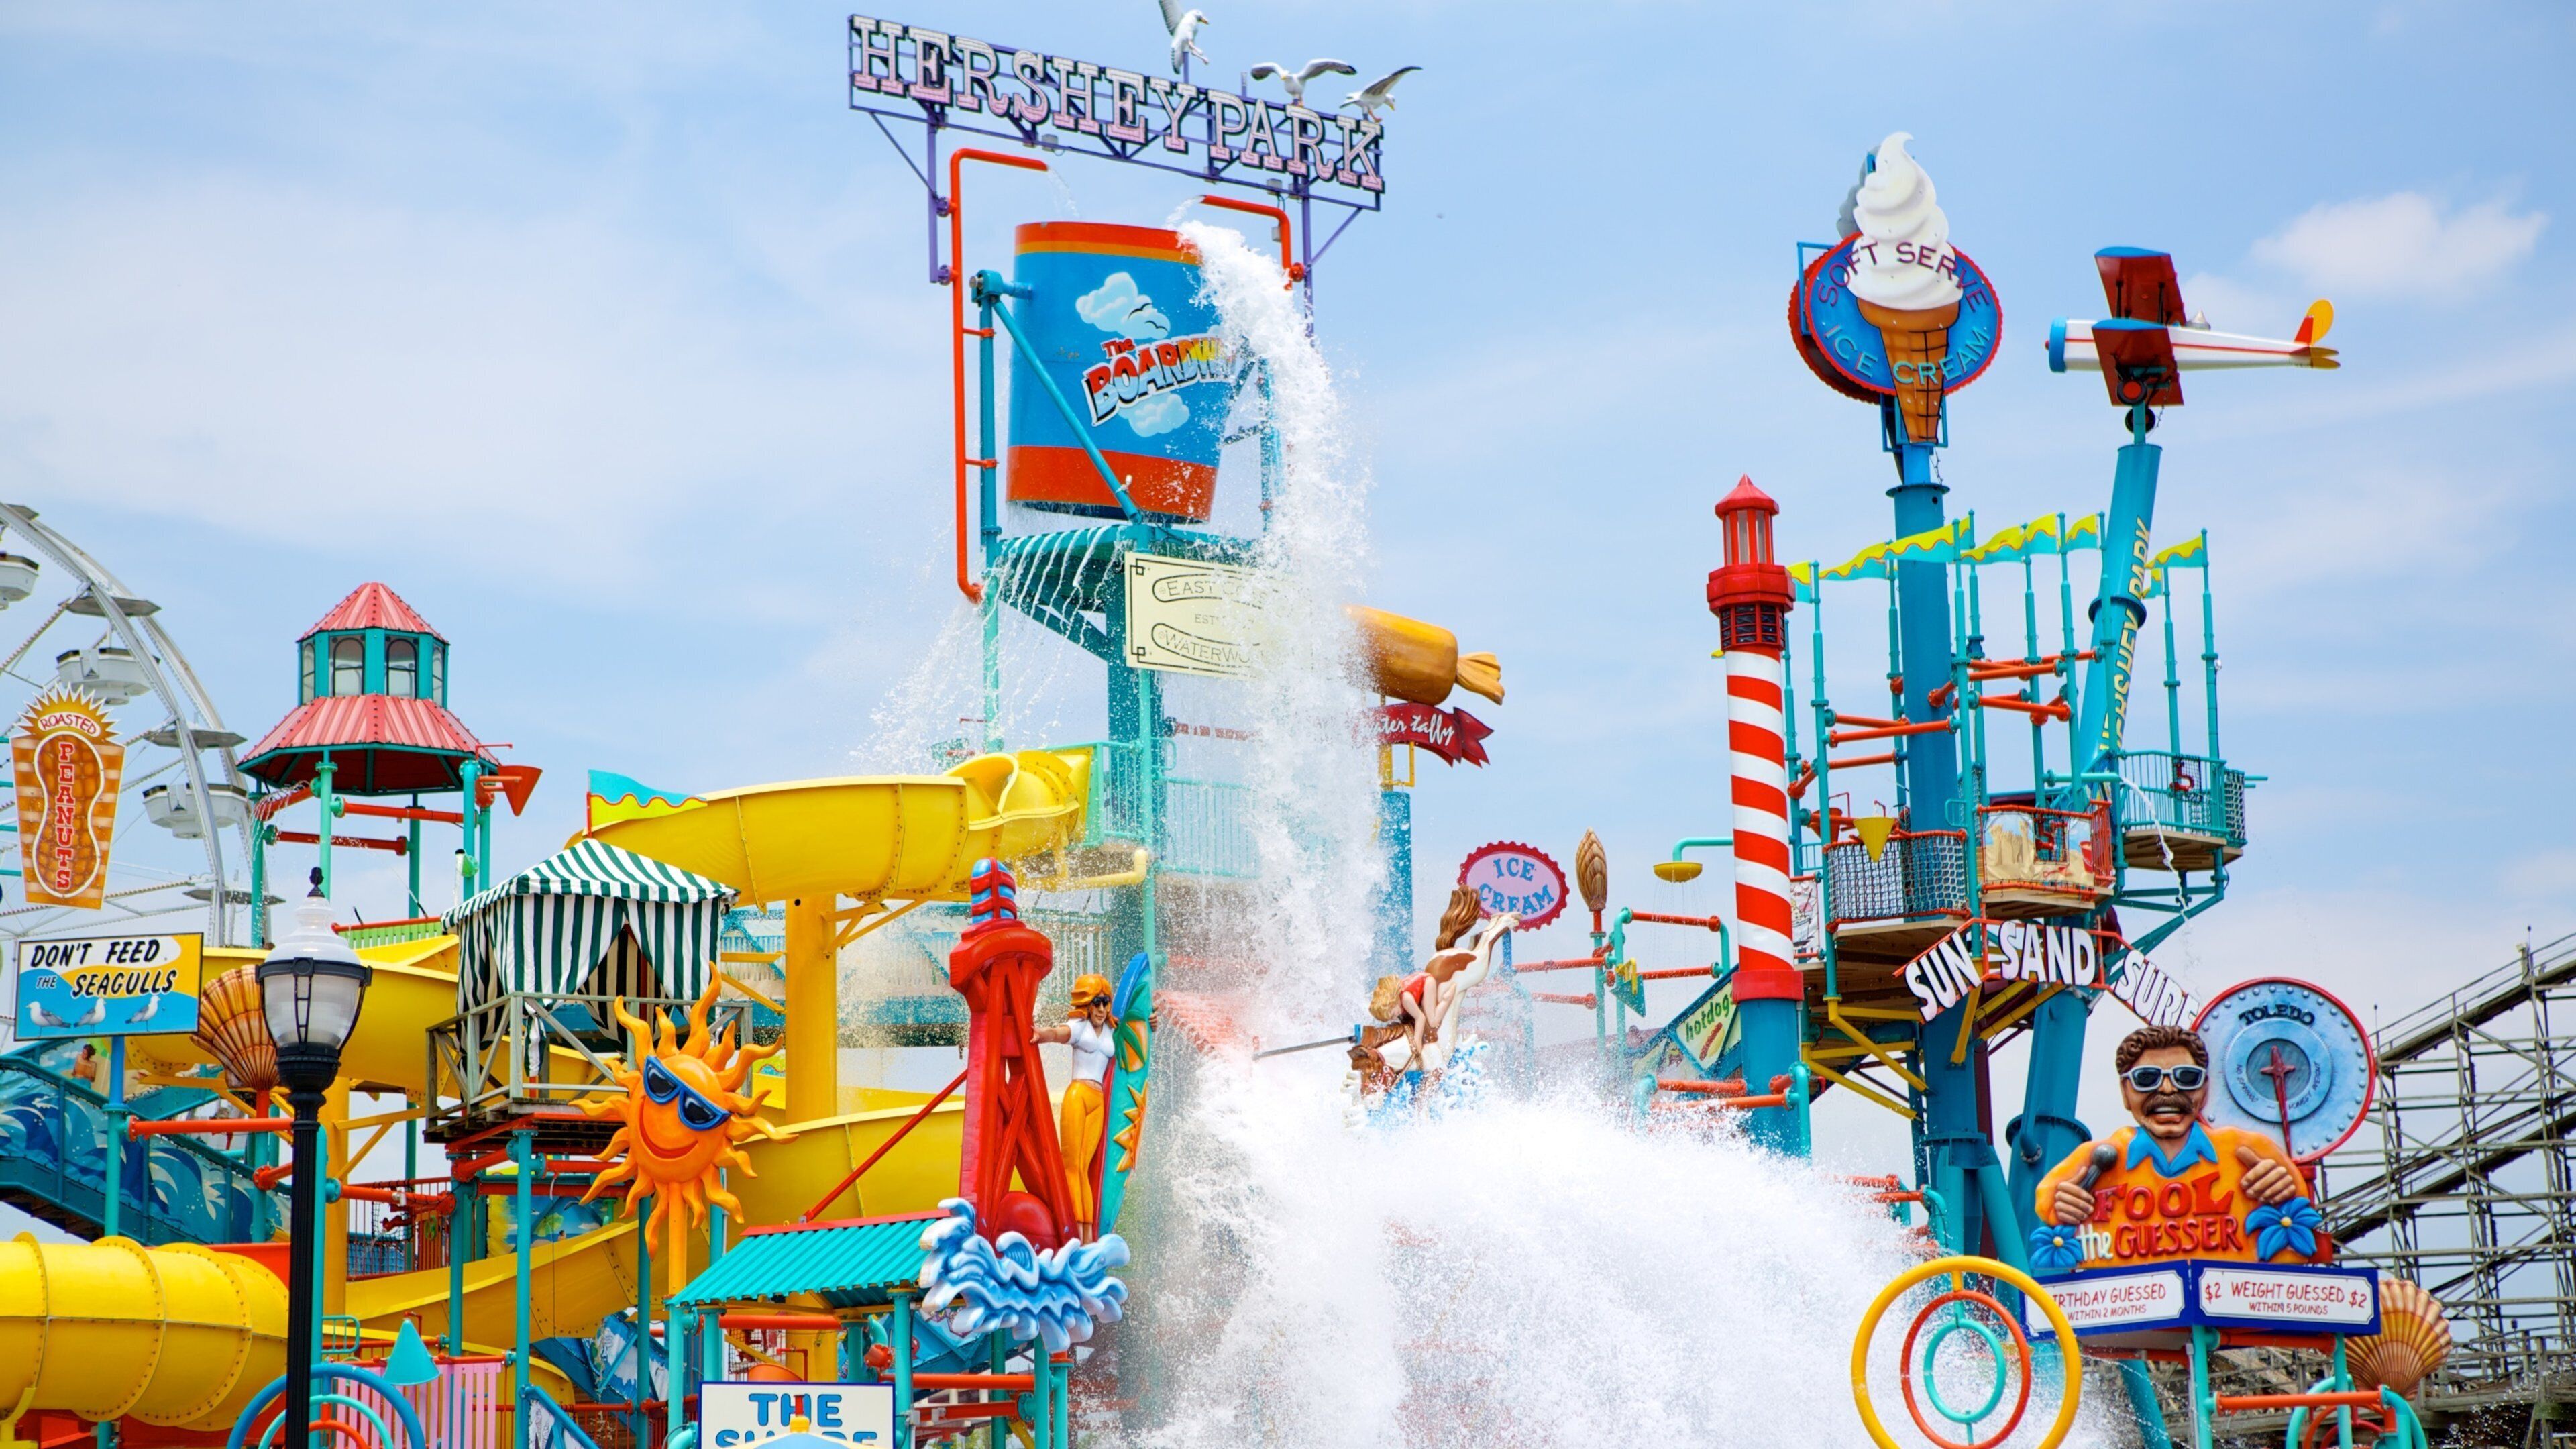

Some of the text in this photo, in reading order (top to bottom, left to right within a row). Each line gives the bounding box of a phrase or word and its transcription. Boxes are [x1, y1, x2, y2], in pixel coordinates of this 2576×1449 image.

[852, 14, 1385, 192] HERSHEYPARK
[1817, 241, 1991, 313] SOFT SERVE
[1103, 338, 1135, 357] The
[1824, 325, 1992, 385] ICE CREAM
[1085, 335, 1233, 423] BOARDW
[2128, 515, 2150, 600] PARK
[1167, 580, 1216, 596] EAST
[40, 714, 97, 735] ROASTED
[1410, 713, 1455, 747] taffy
[56, 743, 75, 890] PEANUTS
[1493, 857, 1535, 882] ICE
[1479, 883, 1554, 916] CREAM
[30, 938, 161, 968] DON'T FEED
[36, 969, 177, 998] THE SEAGULLS
[1904, 930, 1982, 1022] SUN
[1998, 919, 2096, 987] SAND
[2238, 1004, 2316, 1026] TOLEDO
[2093, 1171, 2235, 1223] FOOL
[2076, 1215, 2243, 1262] the GUESSER
[2053, 1283, 2167, 1308] IRTHDAY GUESSED
[2204, 1281, 2367, 1309] $2 WEIGHT GUESSED $2
[2249, 1301, 2328, 1316] WITHIN 5 POUNDS
[2067, 1304, 2147, 1321] WITHIN 2 MONTHS
[748, 1393, 843, 1427] THE
